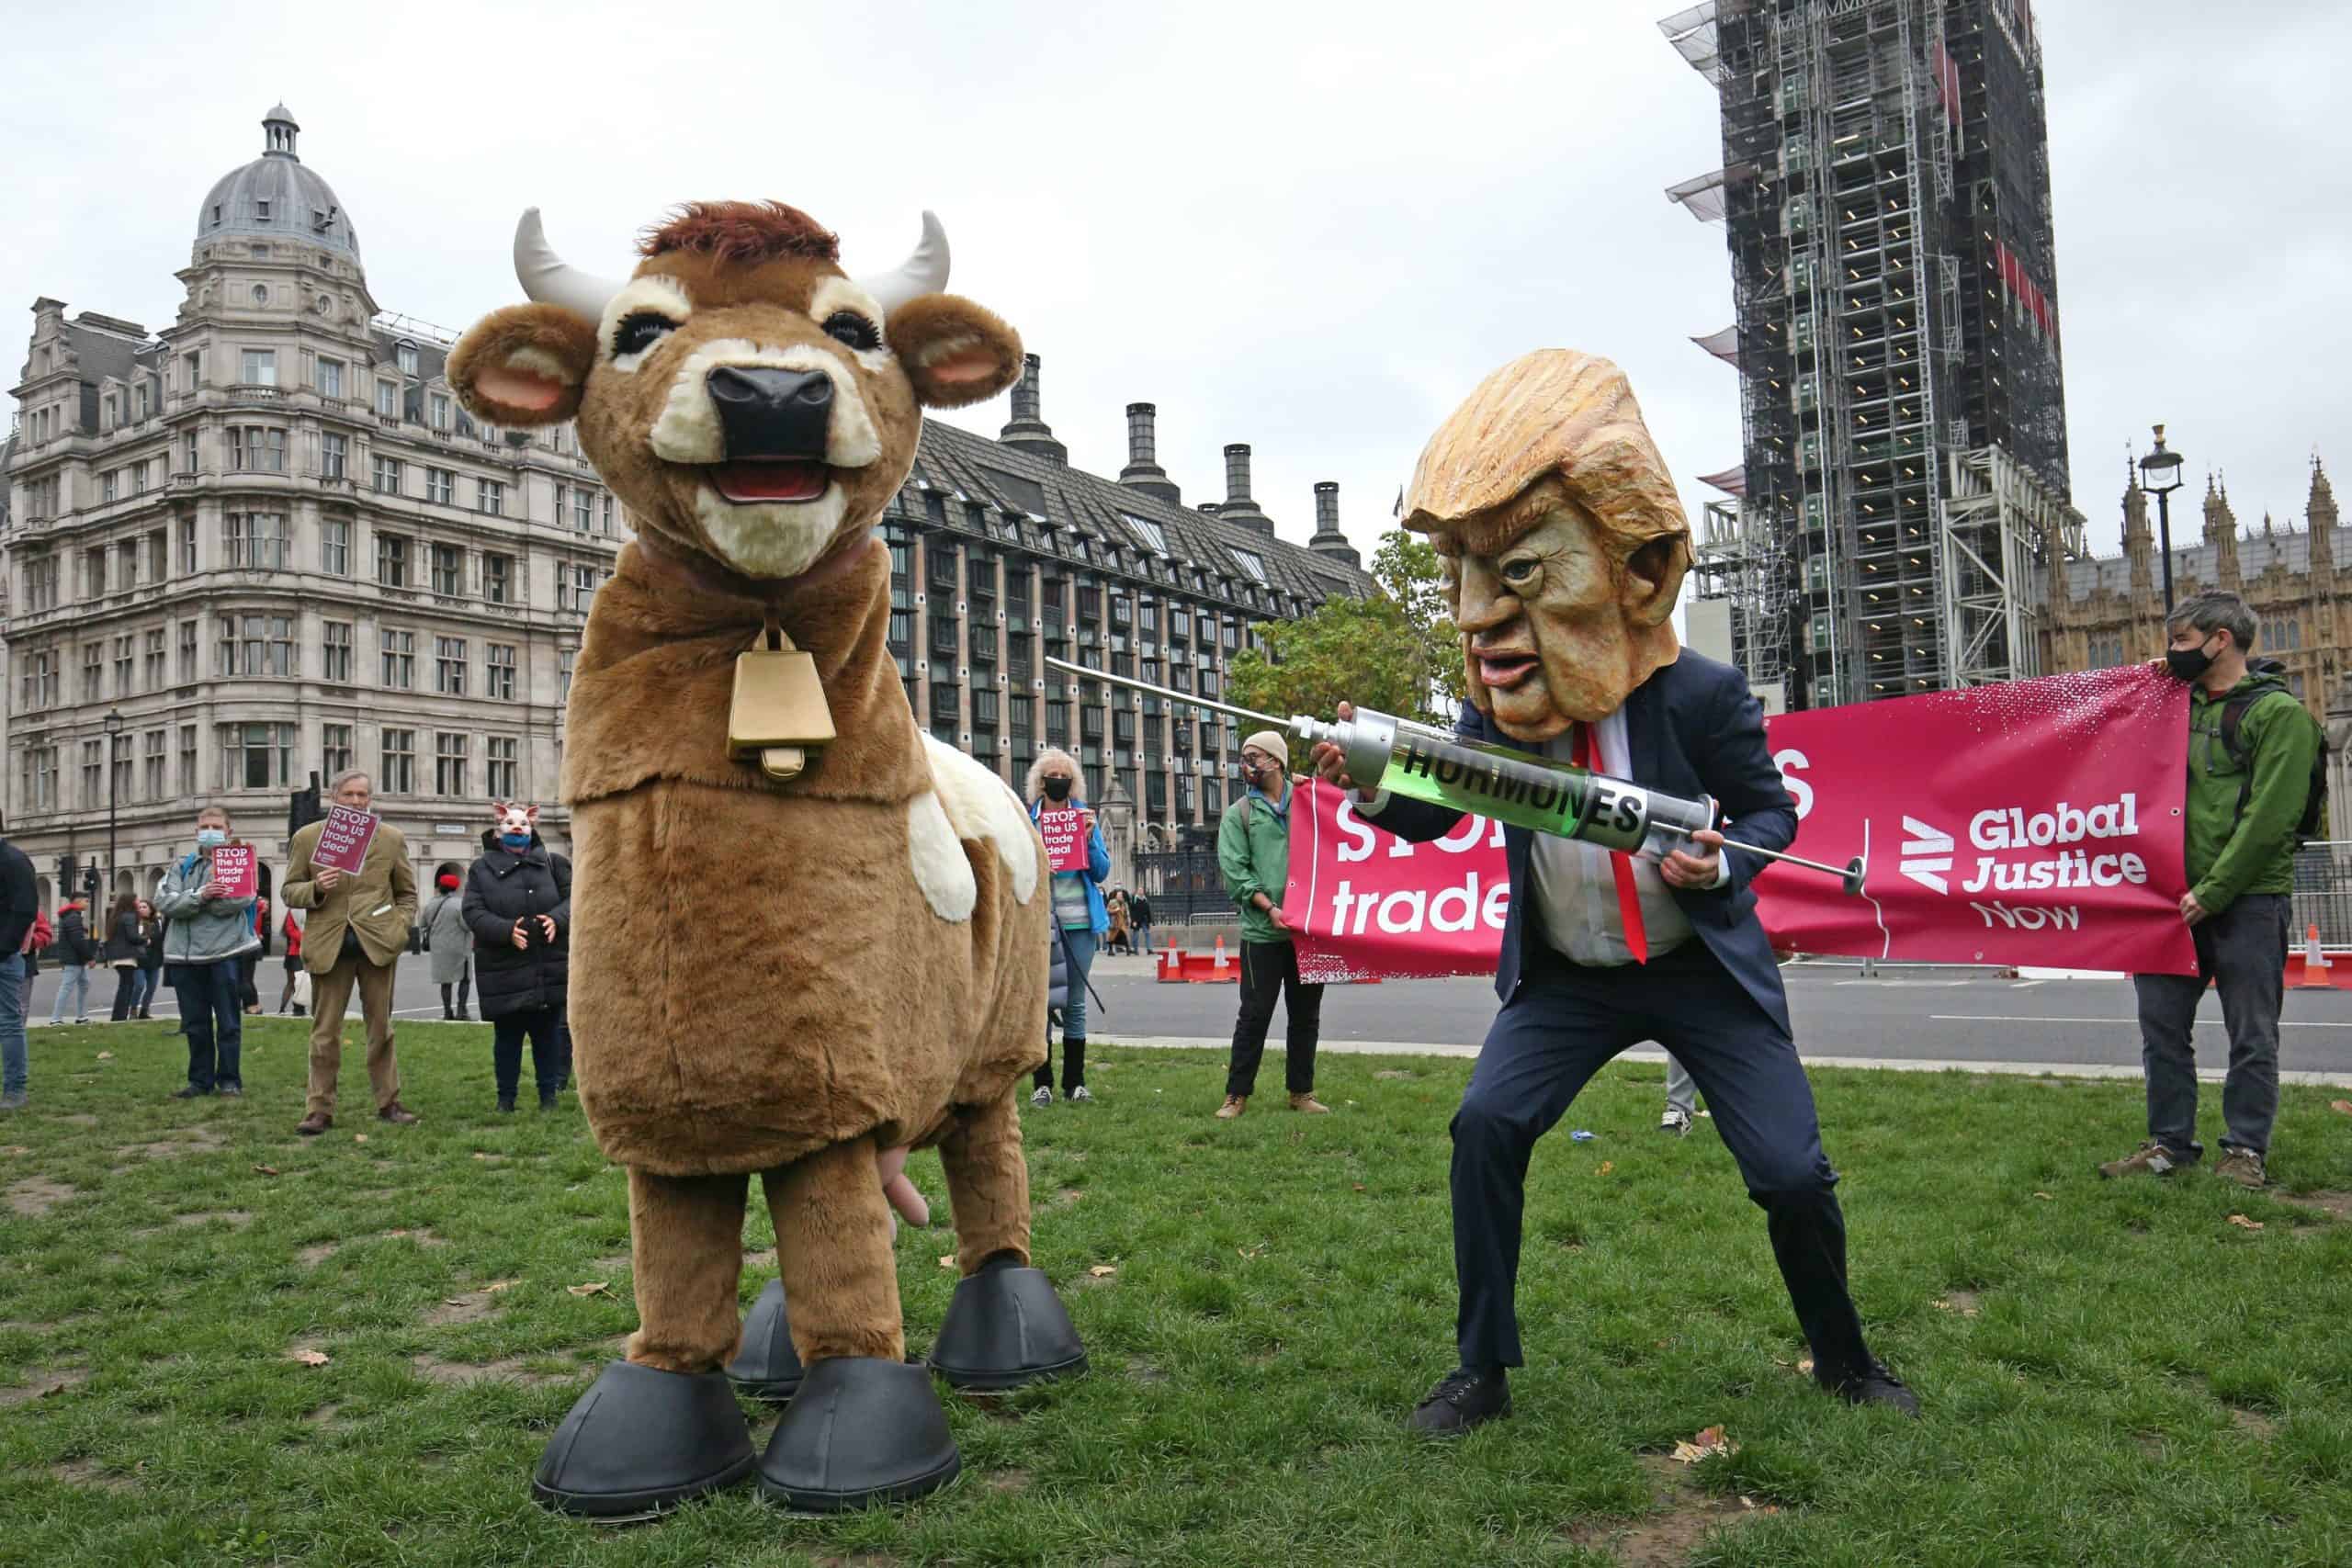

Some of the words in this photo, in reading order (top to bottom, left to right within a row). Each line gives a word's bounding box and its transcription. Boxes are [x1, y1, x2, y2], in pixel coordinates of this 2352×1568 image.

[1402, 738, 1642, 832] HORMONES
[332, 808, 369, 826] STOP
[1043, 810, 1077, 823] STOP
[1969, 793, 2139, 851] Global
[329, 819, 348, 831] the
[350, 825, 366, 836] US
[1044, 825, 1061, 834] the
[1064, 822, 1078, 831] US
[325, 829, 356, 844] trade
[1045, 834, 1073, 844] trade
[216, 848, 247, 857] STOP
[322, 840, 348, 852] deal
[1046, 844, 1070, 855] deal
[235, 858, 248, 866] US
[1962, 849, 2147, 893] Justice
[219, 874, 241, 883] deal
[1332, 871, 1510, 936] trade
